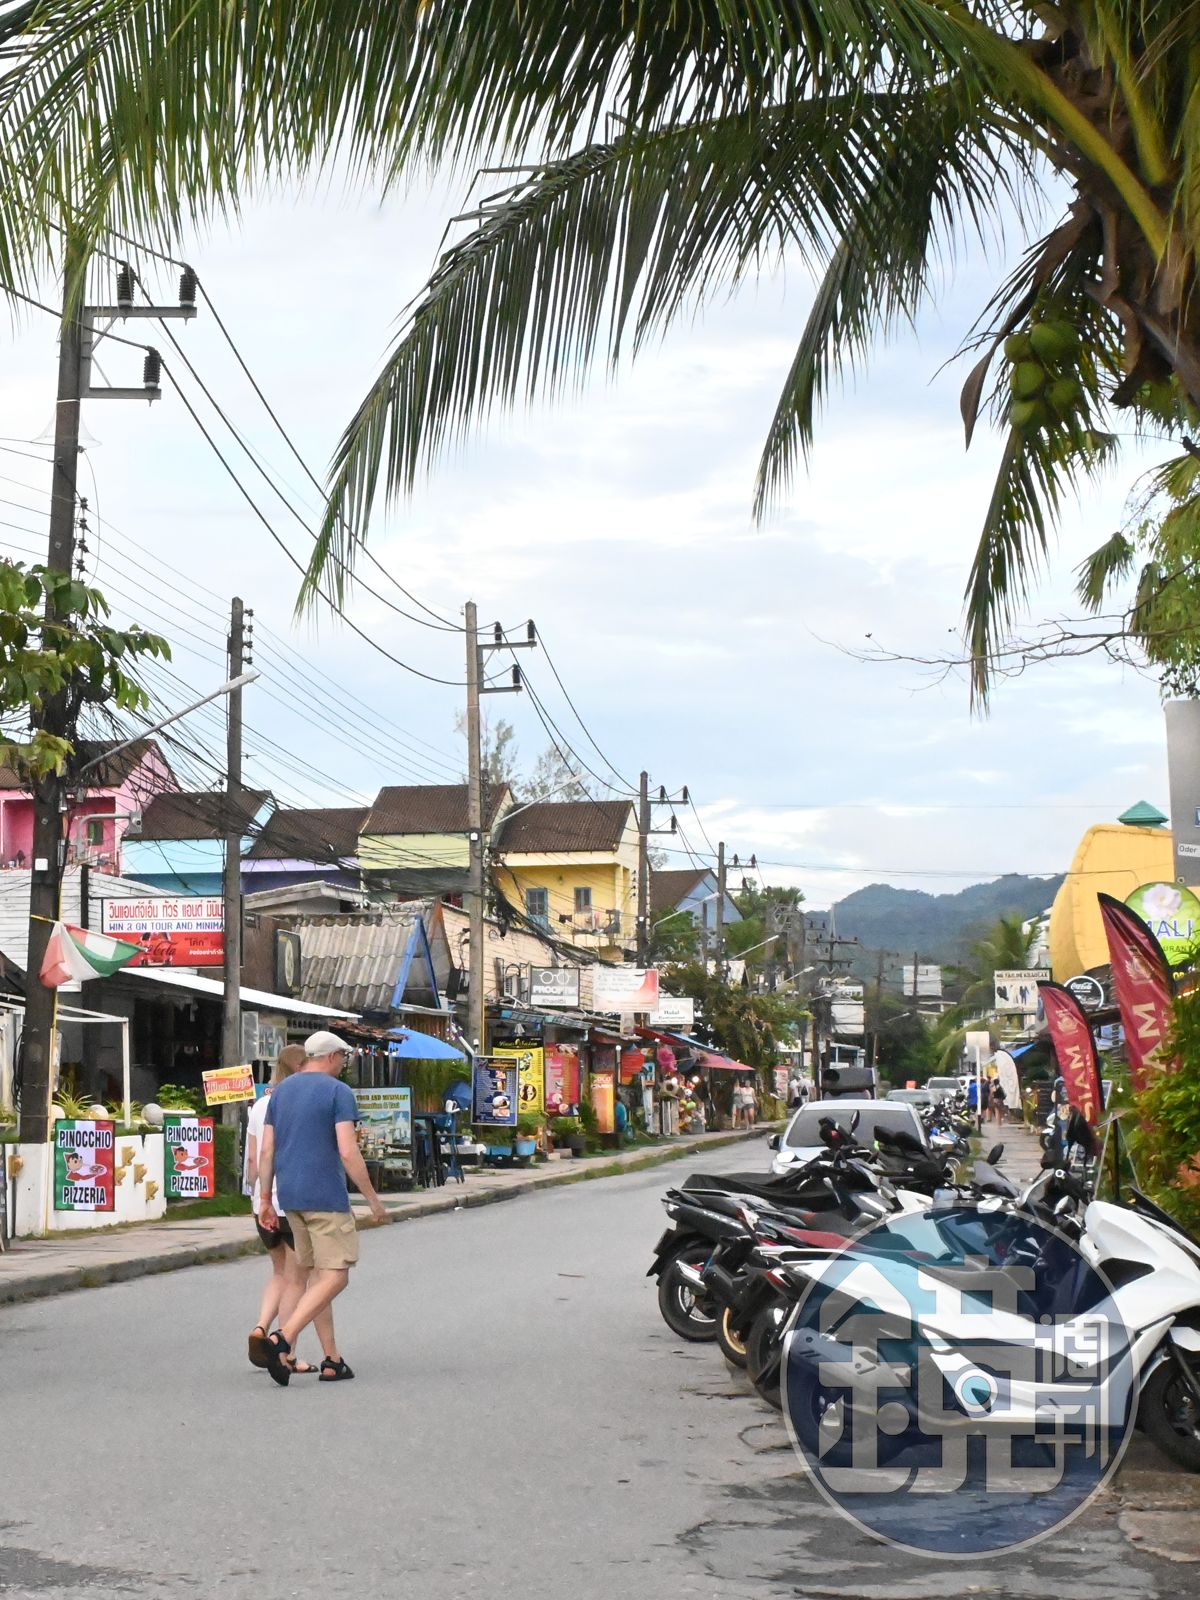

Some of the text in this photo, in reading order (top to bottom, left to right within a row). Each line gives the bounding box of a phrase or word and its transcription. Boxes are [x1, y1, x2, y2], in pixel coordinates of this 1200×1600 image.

[109, 923, 124, 931] WIN
[151, 922, 173, 930] TOUR
[176, 922, 193, 930] AND
[196, 922, 224, 930] MINIMA
[59, 1130, 111, 1148] PINOCCHIO
[167, 1126, 212, 1142] PINOCCHIO
[171, 1176, 208, 1192] PIZZERIA
[63, 1186, 106, 1204] PIZZERIA
